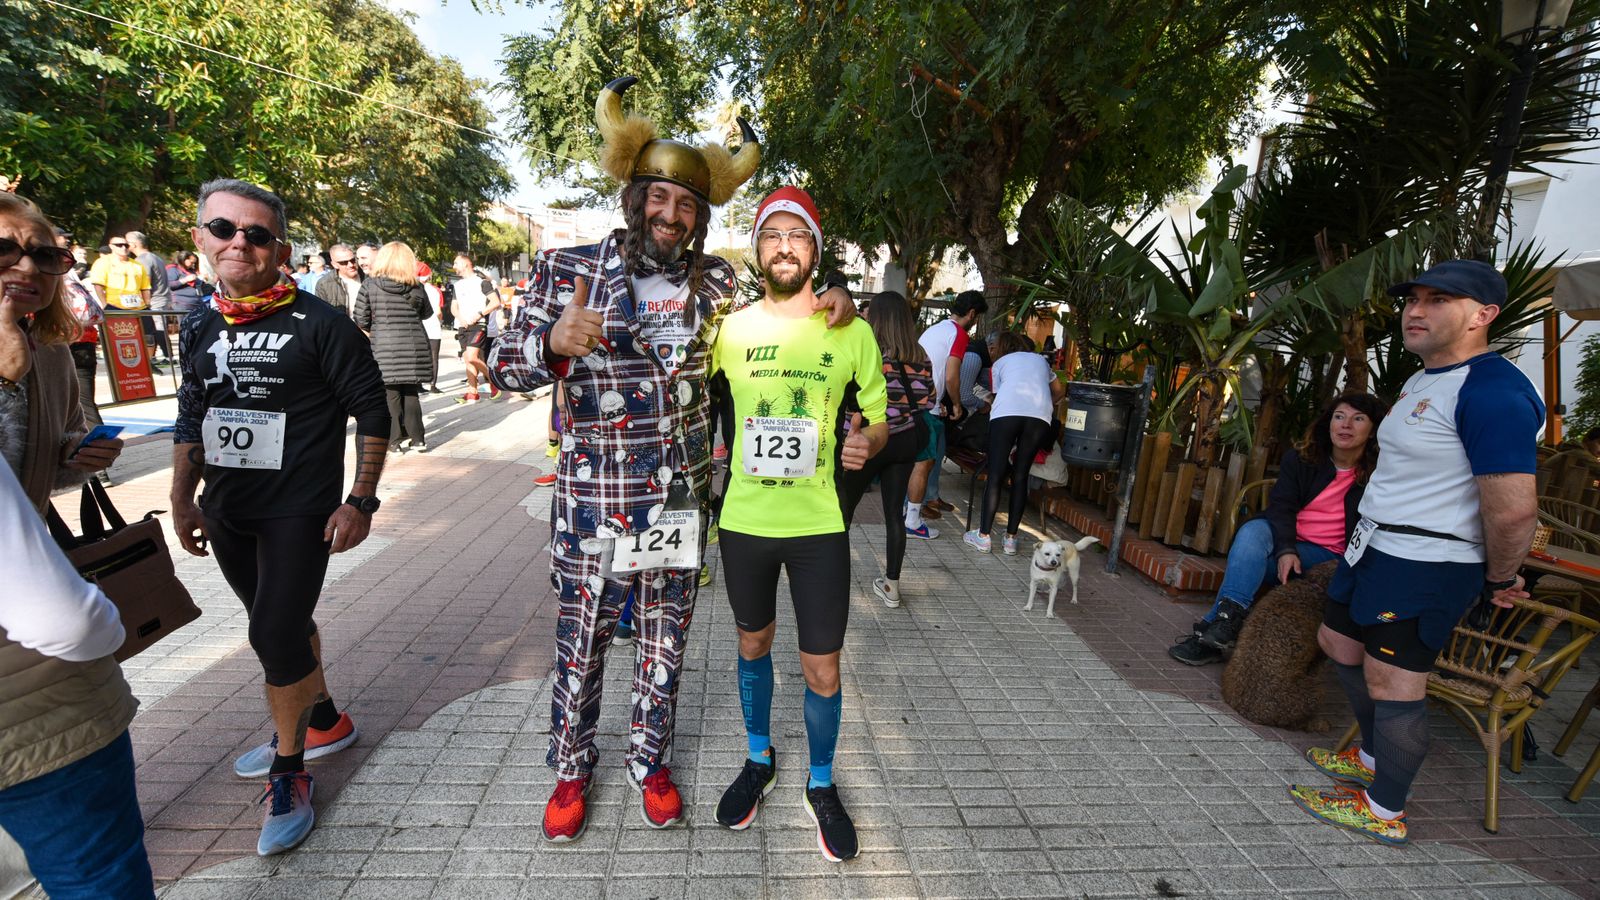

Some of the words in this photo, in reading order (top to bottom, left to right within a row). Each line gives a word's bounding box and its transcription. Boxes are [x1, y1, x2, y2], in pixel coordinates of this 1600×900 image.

[233, 332, 294, 350] XIV
[746, 345, 779, 362] VIII
[750, 369, 779, 378] MEDIA
[781, 369, 828, 382] MARATÓN
[249, 386, 257, 395] 8
[219, 416, 249, 424] TARIFEÑA
[234, 411, 280, 420] SILVESTRE
[218, 426, 254, 450] 90
[754, 434, 801, 460] 123
[631, 528, 682, 552] 124
